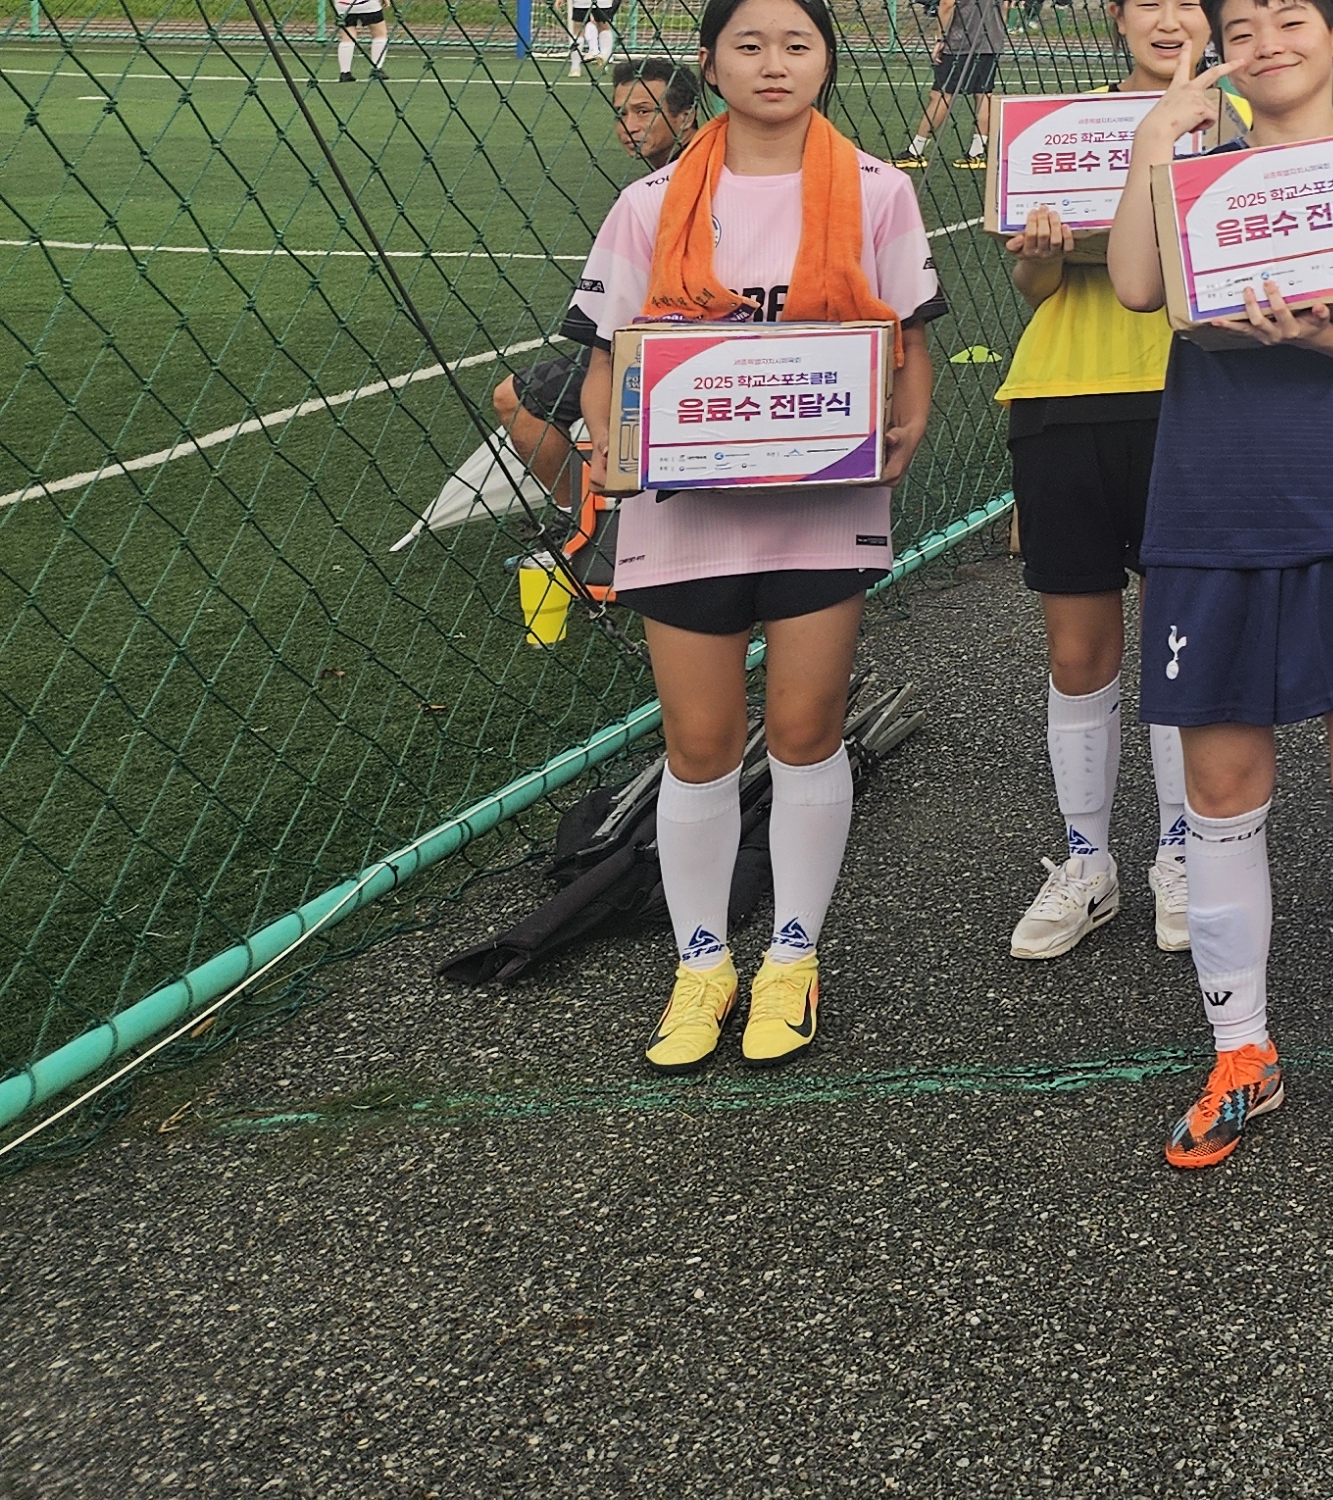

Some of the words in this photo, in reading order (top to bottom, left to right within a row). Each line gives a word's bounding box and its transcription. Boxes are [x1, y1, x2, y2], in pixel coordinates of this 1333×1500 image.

[1044, 132, 1078, 145] 2025
[1031, 151, 1101, 175] 음료수
[1226, 191, 1268, 210] 2025
[1215, 210, 1299, 248] 음료수
[693, 376, 733, 390] 2025
[737, 371, 837, 388] 학교스포츠클럽
[677, 396, 761, 424] 음료수
[770, 391, 851, 420] 전달식
